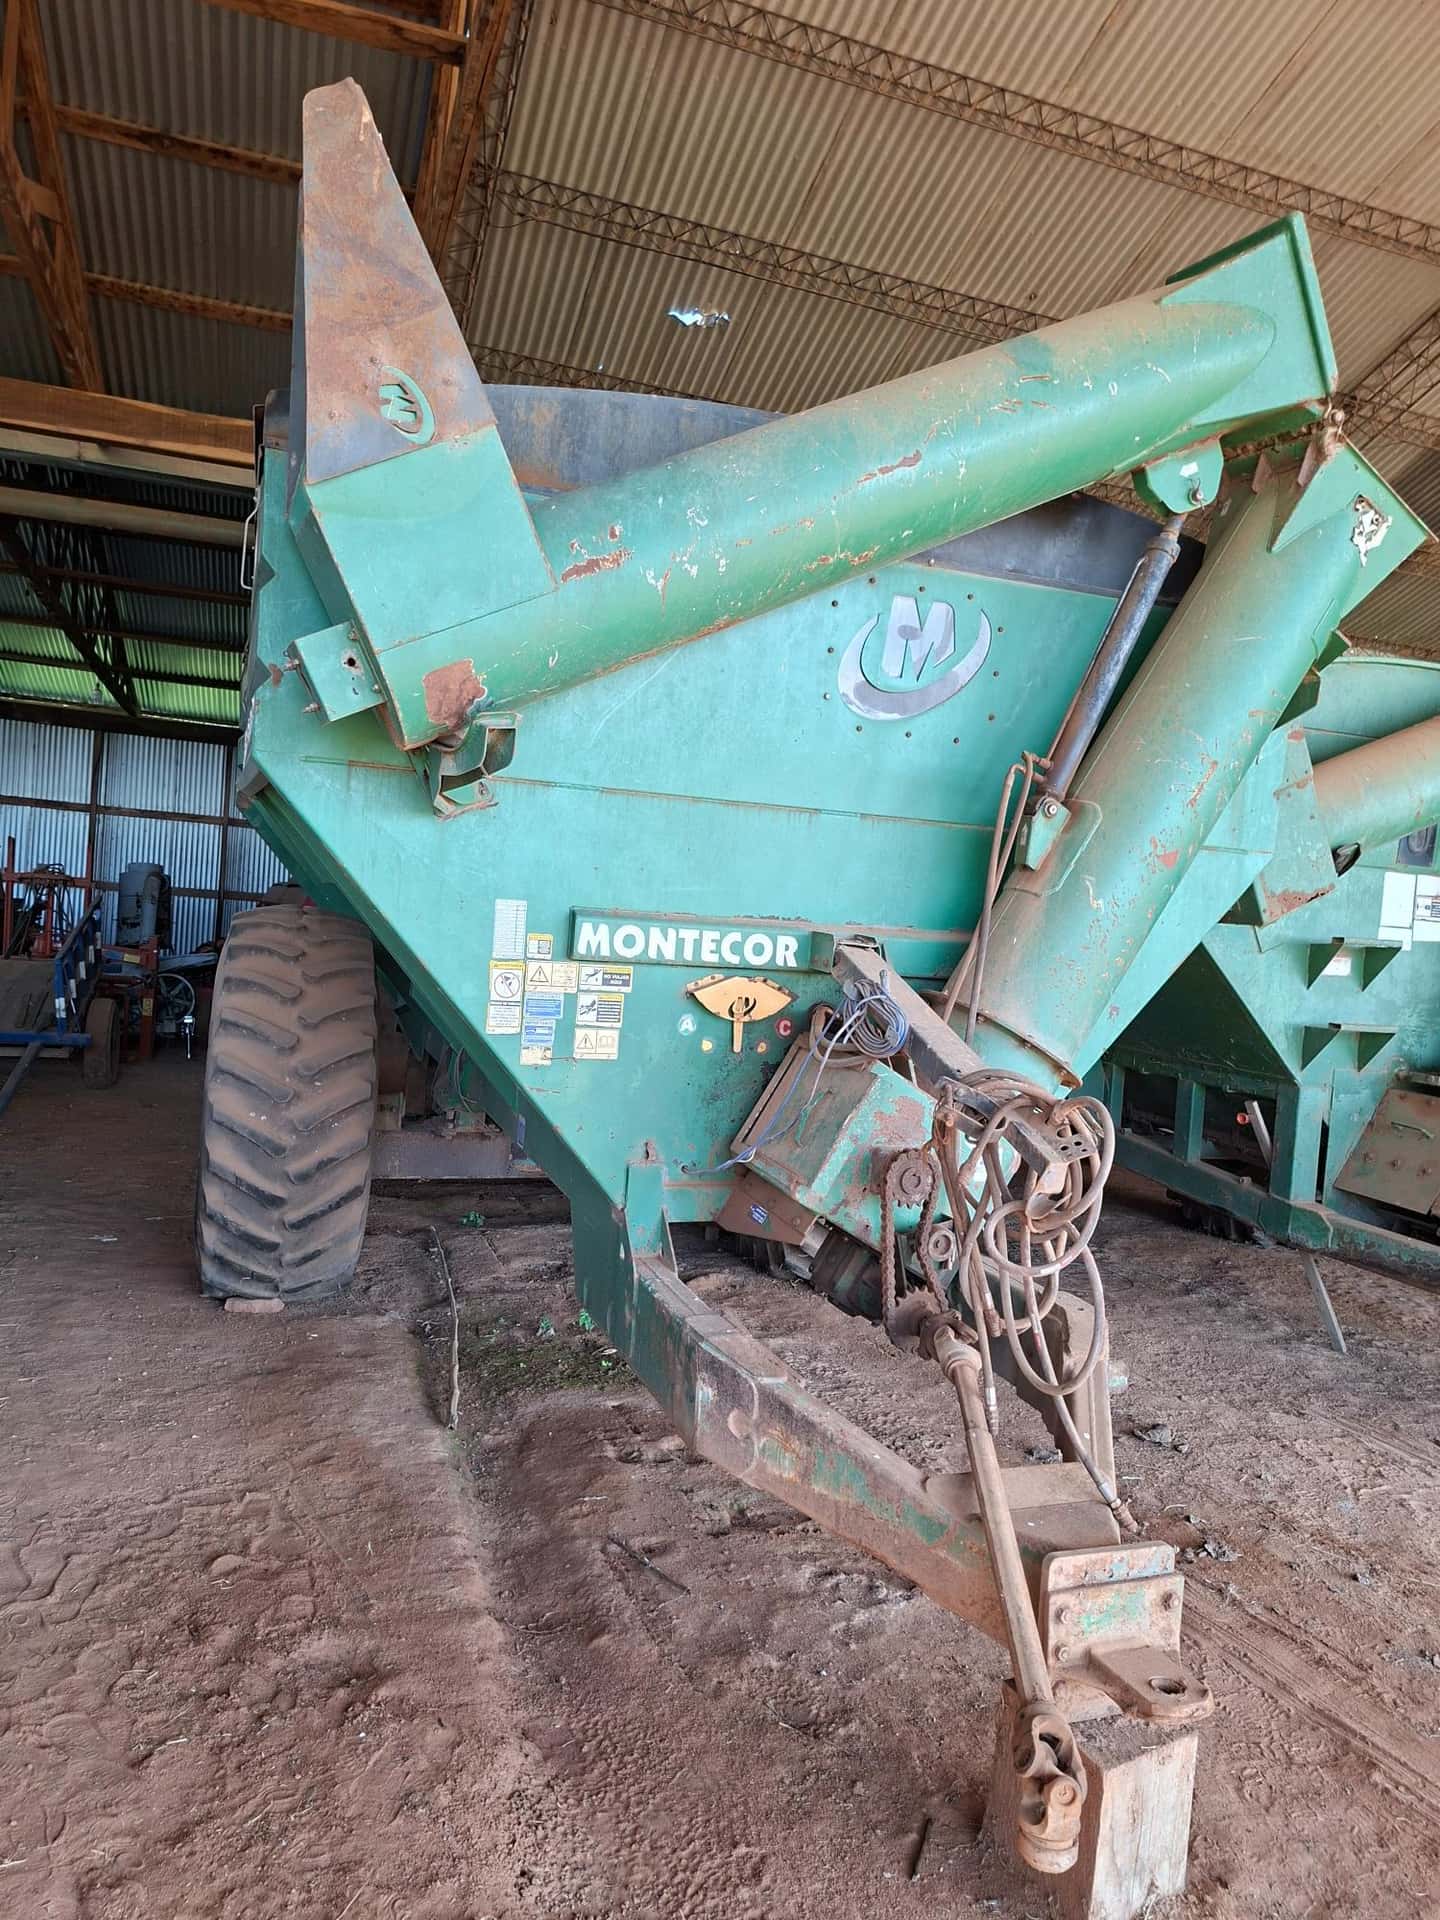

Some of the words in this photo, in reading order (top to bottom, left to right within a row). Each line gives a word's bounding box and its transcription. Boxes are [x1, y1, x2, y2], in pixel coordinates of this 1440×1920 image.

[882, 595, 955, 682] M
[578, 922, 799, 967] MONTECOR
[779, 1021, 792, 1036] C
